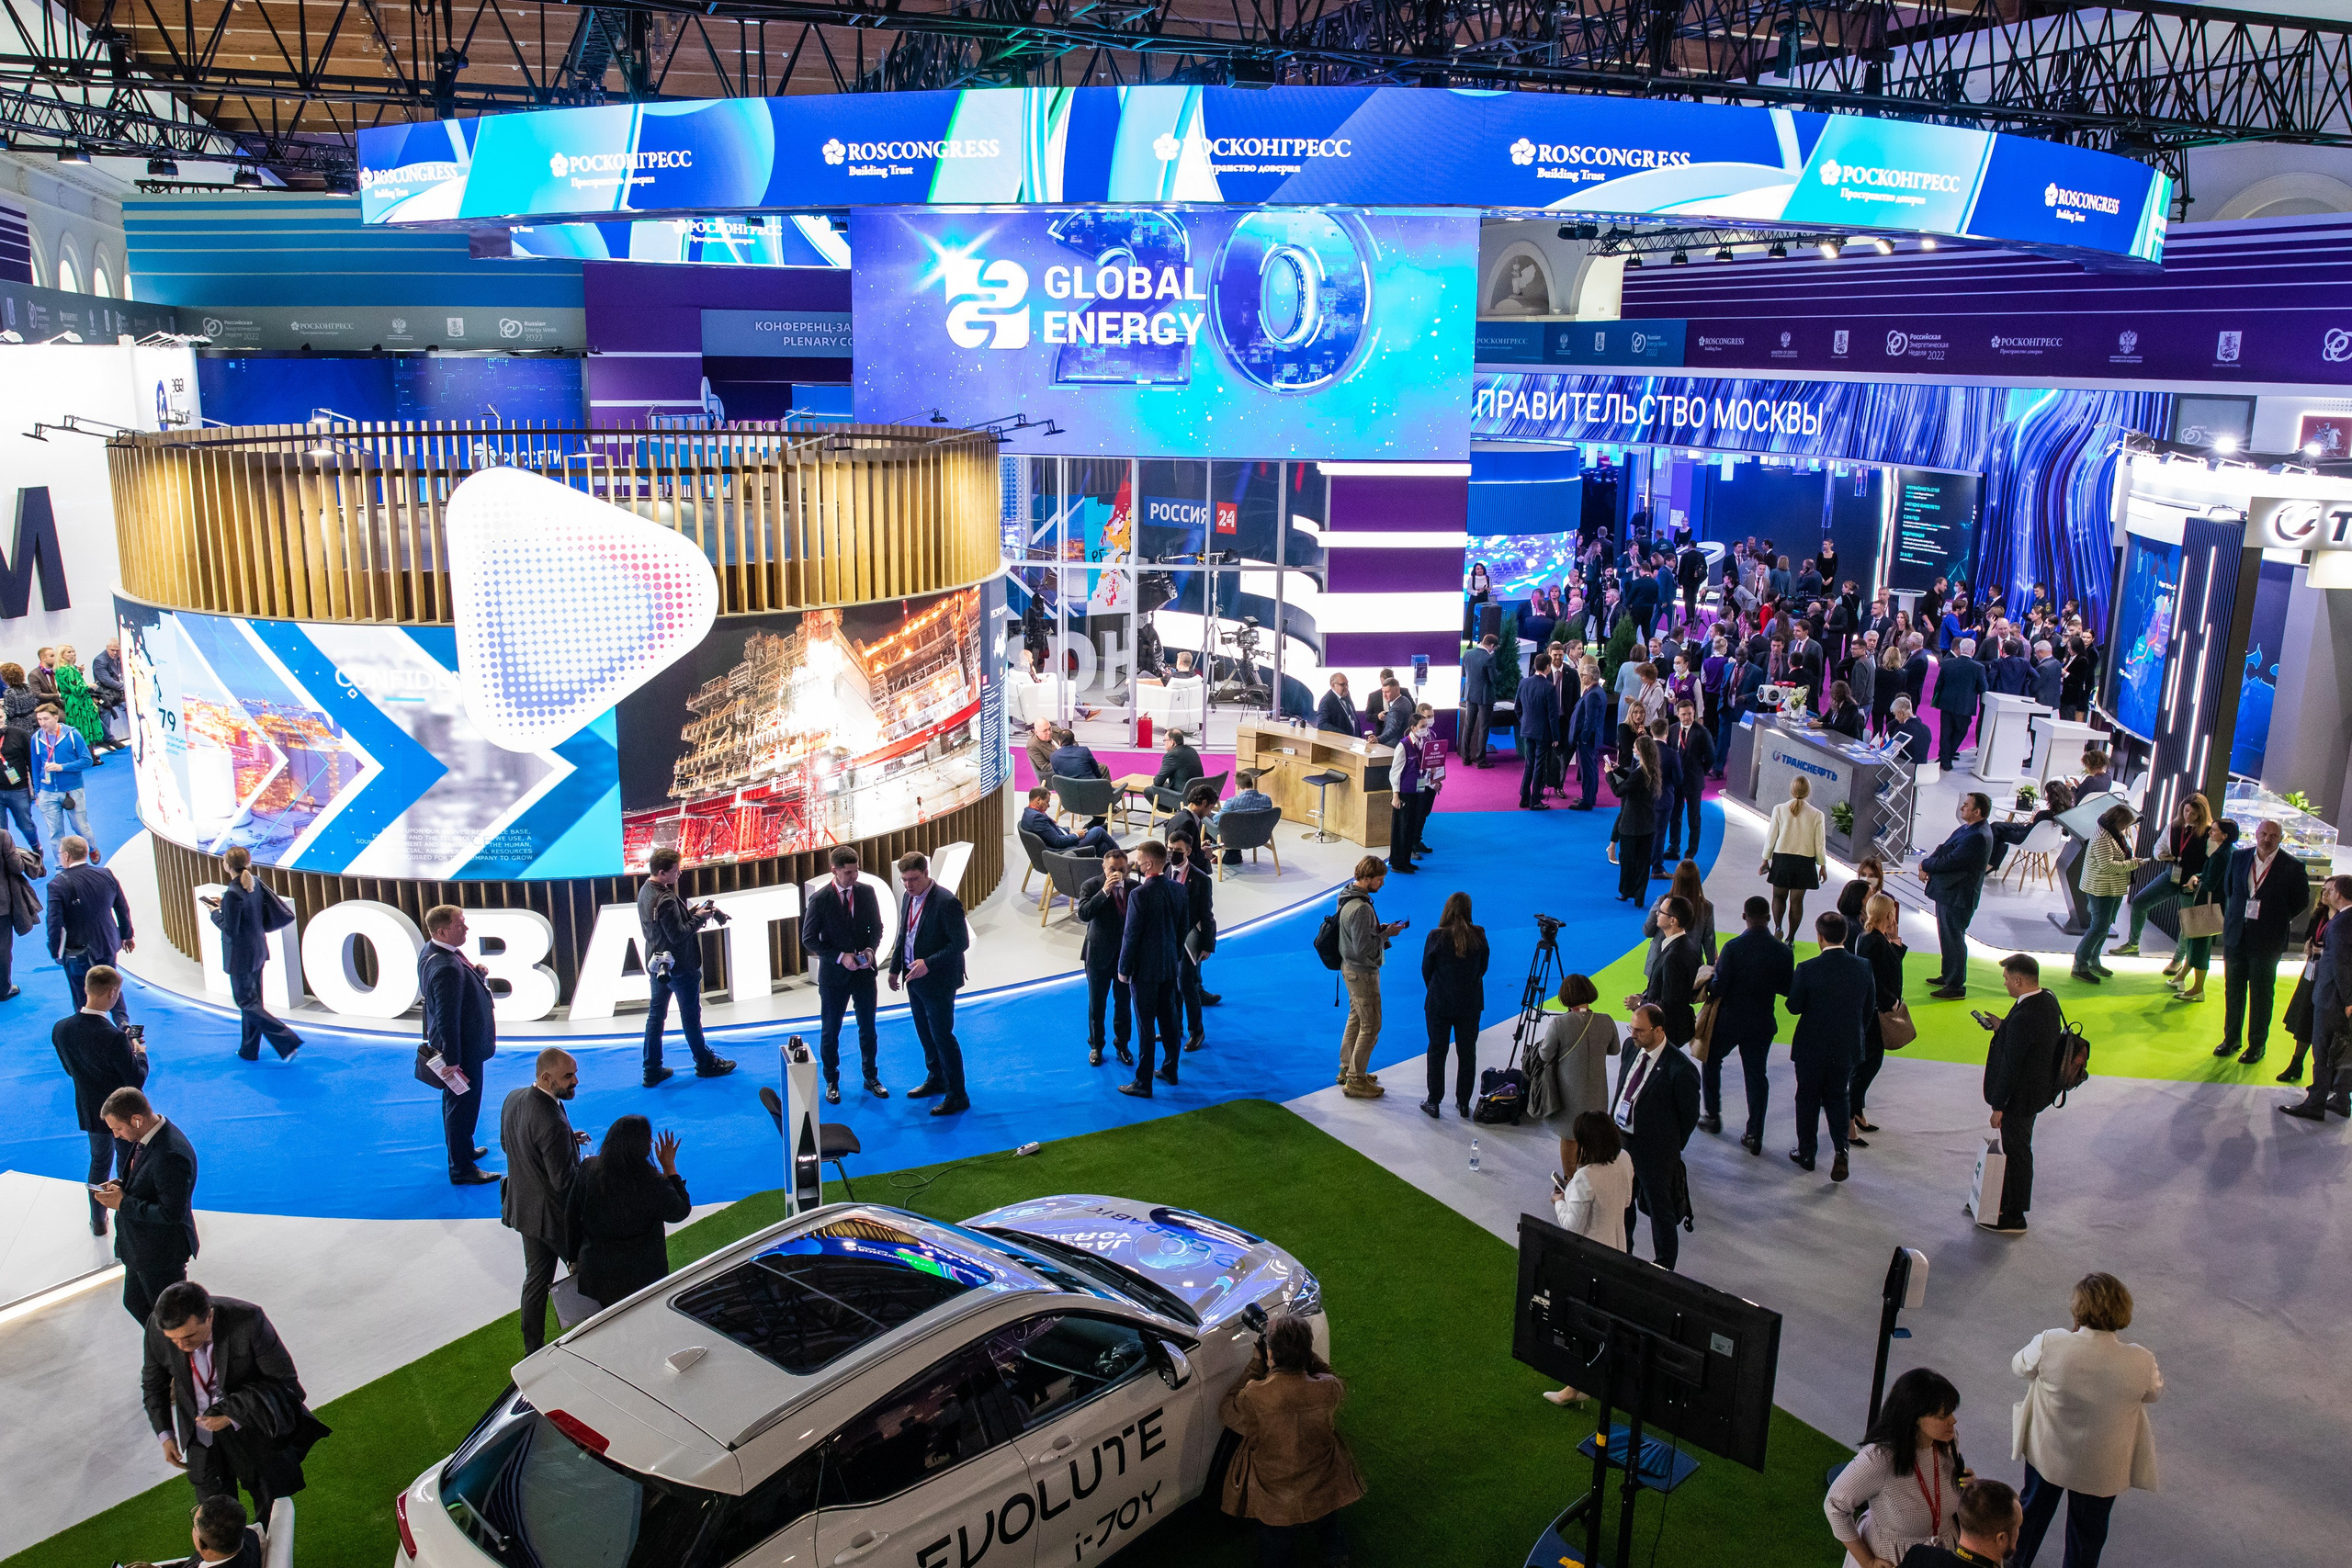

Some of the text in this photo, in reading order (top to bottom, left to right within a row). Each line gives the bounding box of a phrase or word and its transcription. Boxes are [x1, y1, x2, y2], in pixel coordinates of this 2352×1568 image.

[848, 140, 1000, 161] ROSCONGRESS
[1183, 138, 1351, 157] ОСКОНГРЕСС
[1537, 144, 1690, 170] ROSCONGRESS
[570, 151, 692, 173] РОСКОНГРЕСС
[849, 164, 913, 178] Building Trust
[373, 164, 458, 185] ROSCONGRESS
[1537, 167, 1605, 183] Building Trust
[1841, 165, 1961, 193] РОСКОНГРЕСС
[2057, 188, 2120, 215] ROSCONGRESS
[1045, 265, 1206, 301] GLOBAL
[755, 321, 853, 333] КОНФЕРЕНЦ-ЗА
[1044, 310, 1207, 345] ENERGY
[784, 336, 838, 347] PLENARY
[1476, 337, 1528, 345] РОСКОНГРЕСС
[1705, 337, 1745, 345] ROSCONGRESS
[2000, 337, 2064, 347] РОСКОНГРЕСС
[1645, 348, 1658, 356] 2022
[1927, 350, 1945, 360] 2022
[1476, 389, 1824, 435] ПРАВИТЕЛЬСТВО МОСКВЫ
[1149, 502, 1236, 528] РОССИЯ 24
[158, 707, 176, 732] 79
[1781, 753, 1838, 782] ТРАНСНЕФТЬ
[915, 1406, 1167, 1568] EVOLUTE
[1956, 1547, 1973, 1560] Nikon
